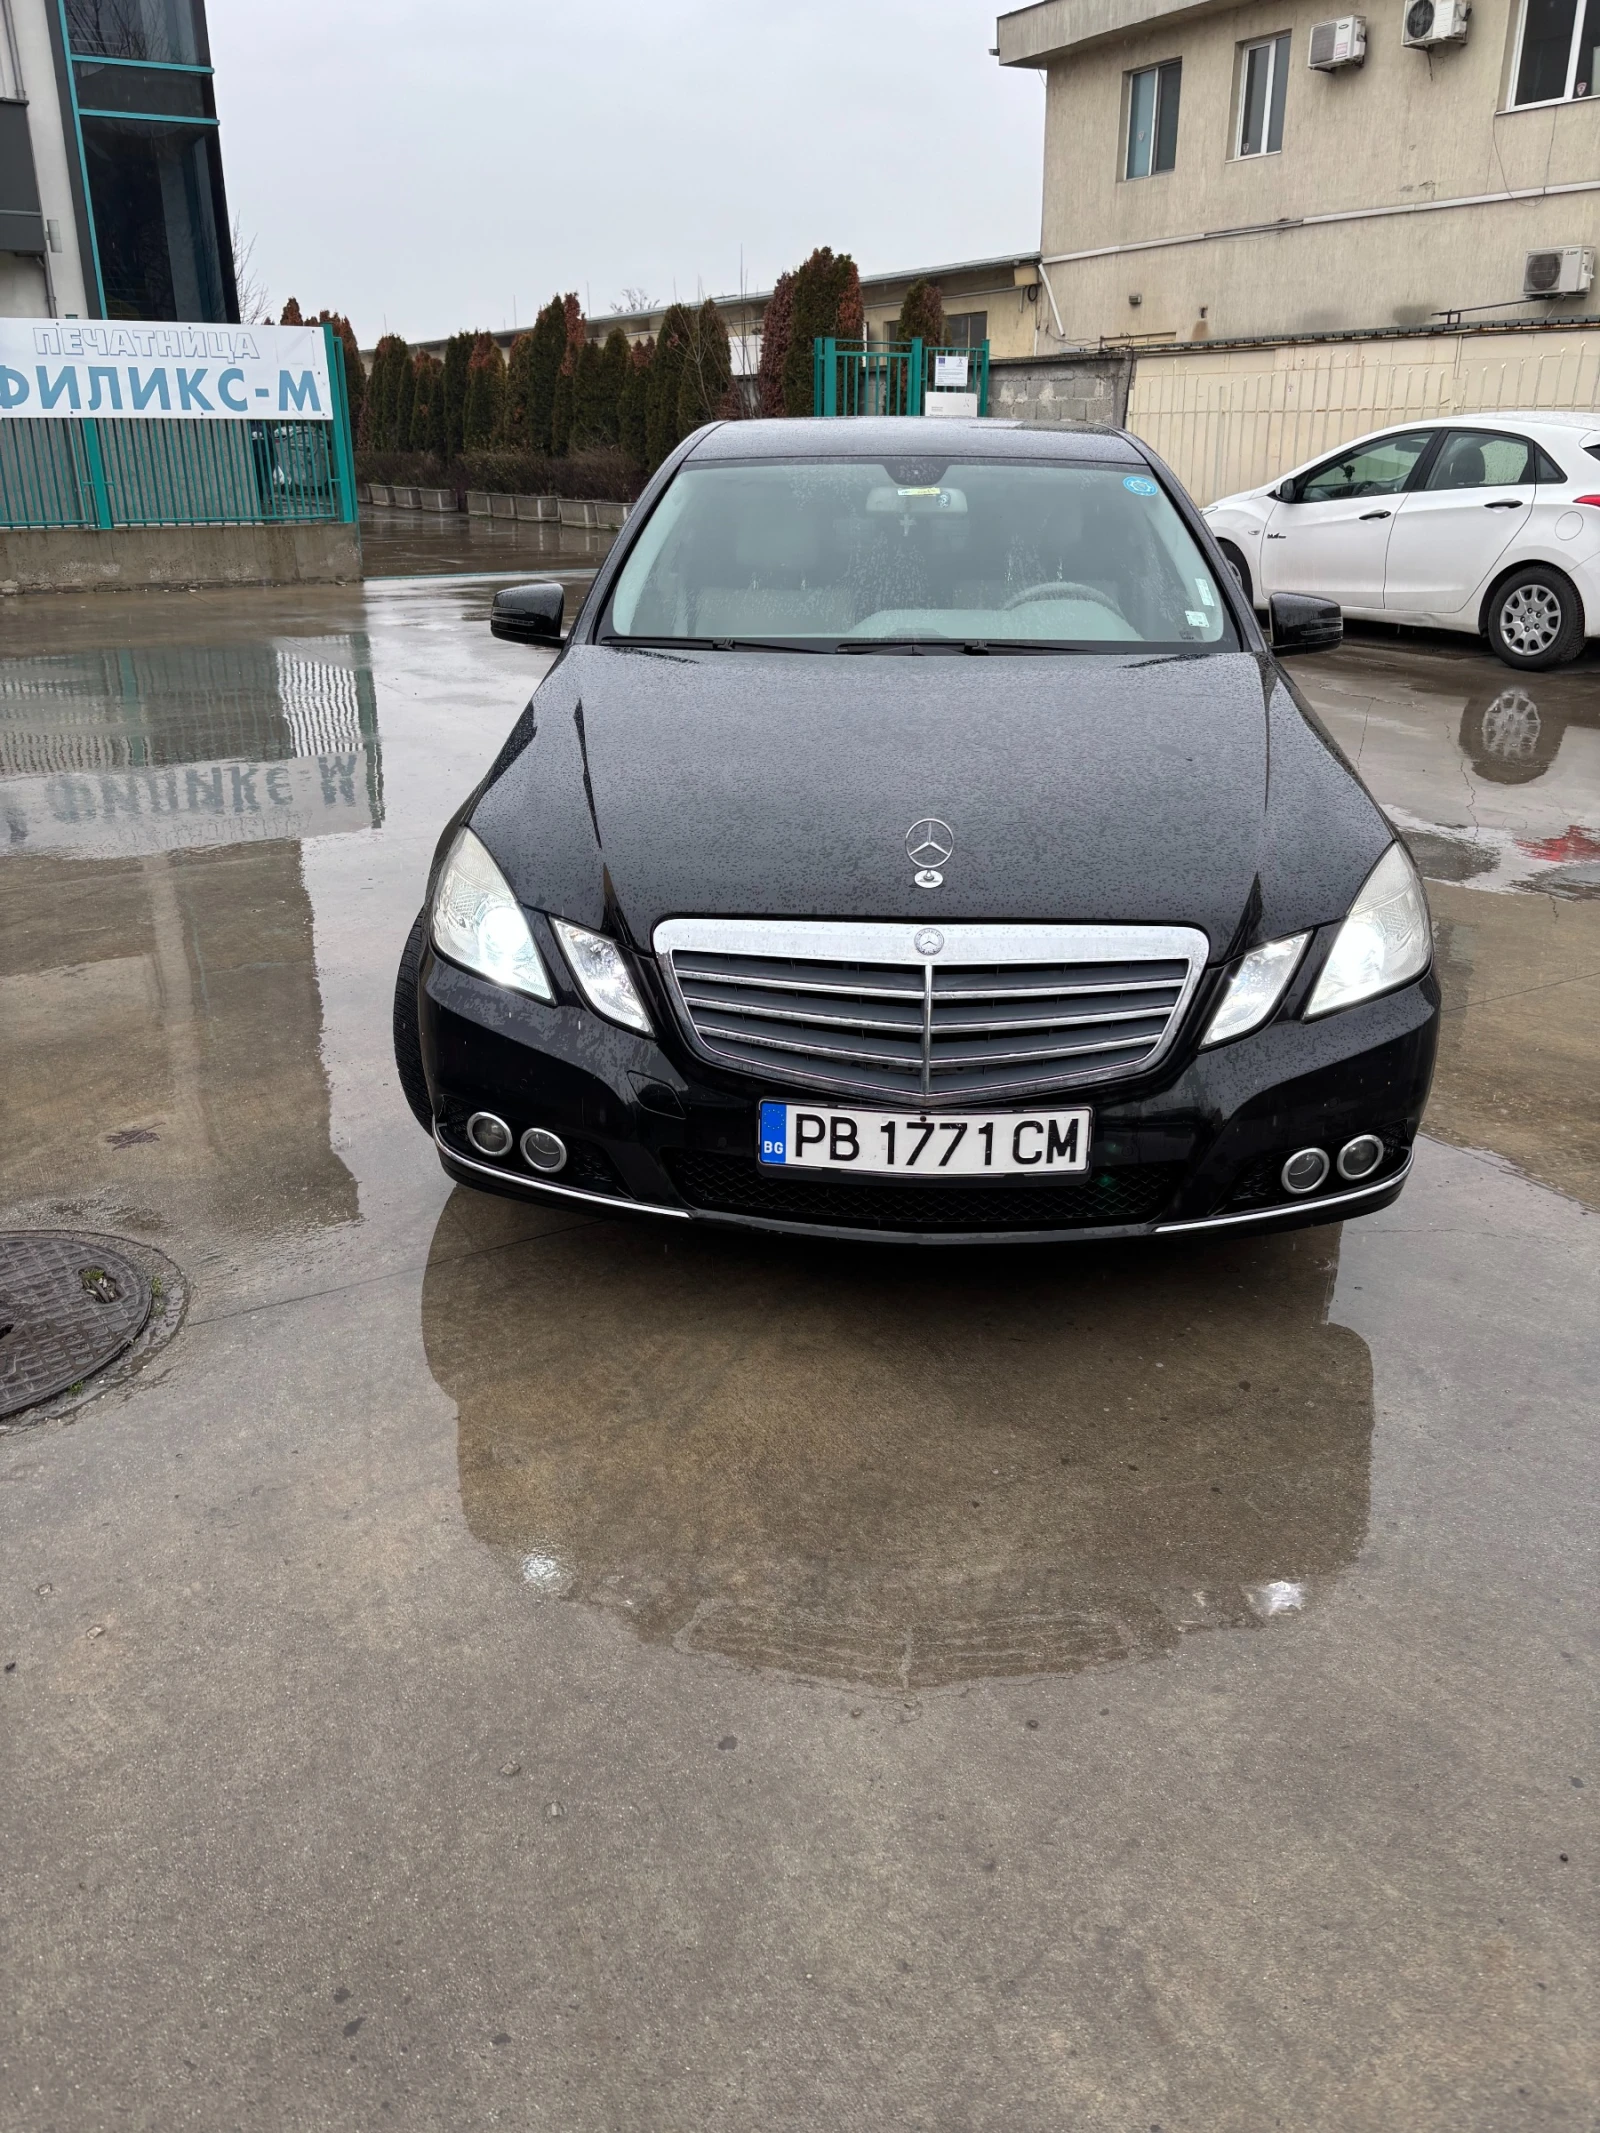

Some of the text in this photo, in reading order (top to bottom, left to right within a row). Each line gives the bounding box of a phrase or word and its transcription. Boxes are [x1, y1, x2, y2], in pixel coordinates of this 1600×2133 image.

[33, 327, 260, 364] ПЕЧАТНИЦА
[0, 365, 322, 412] ФИЛИКС-М
[764, 1140, 783, 1154] BG
[795, 1113, 1080, 1167] PB 1771 CM
